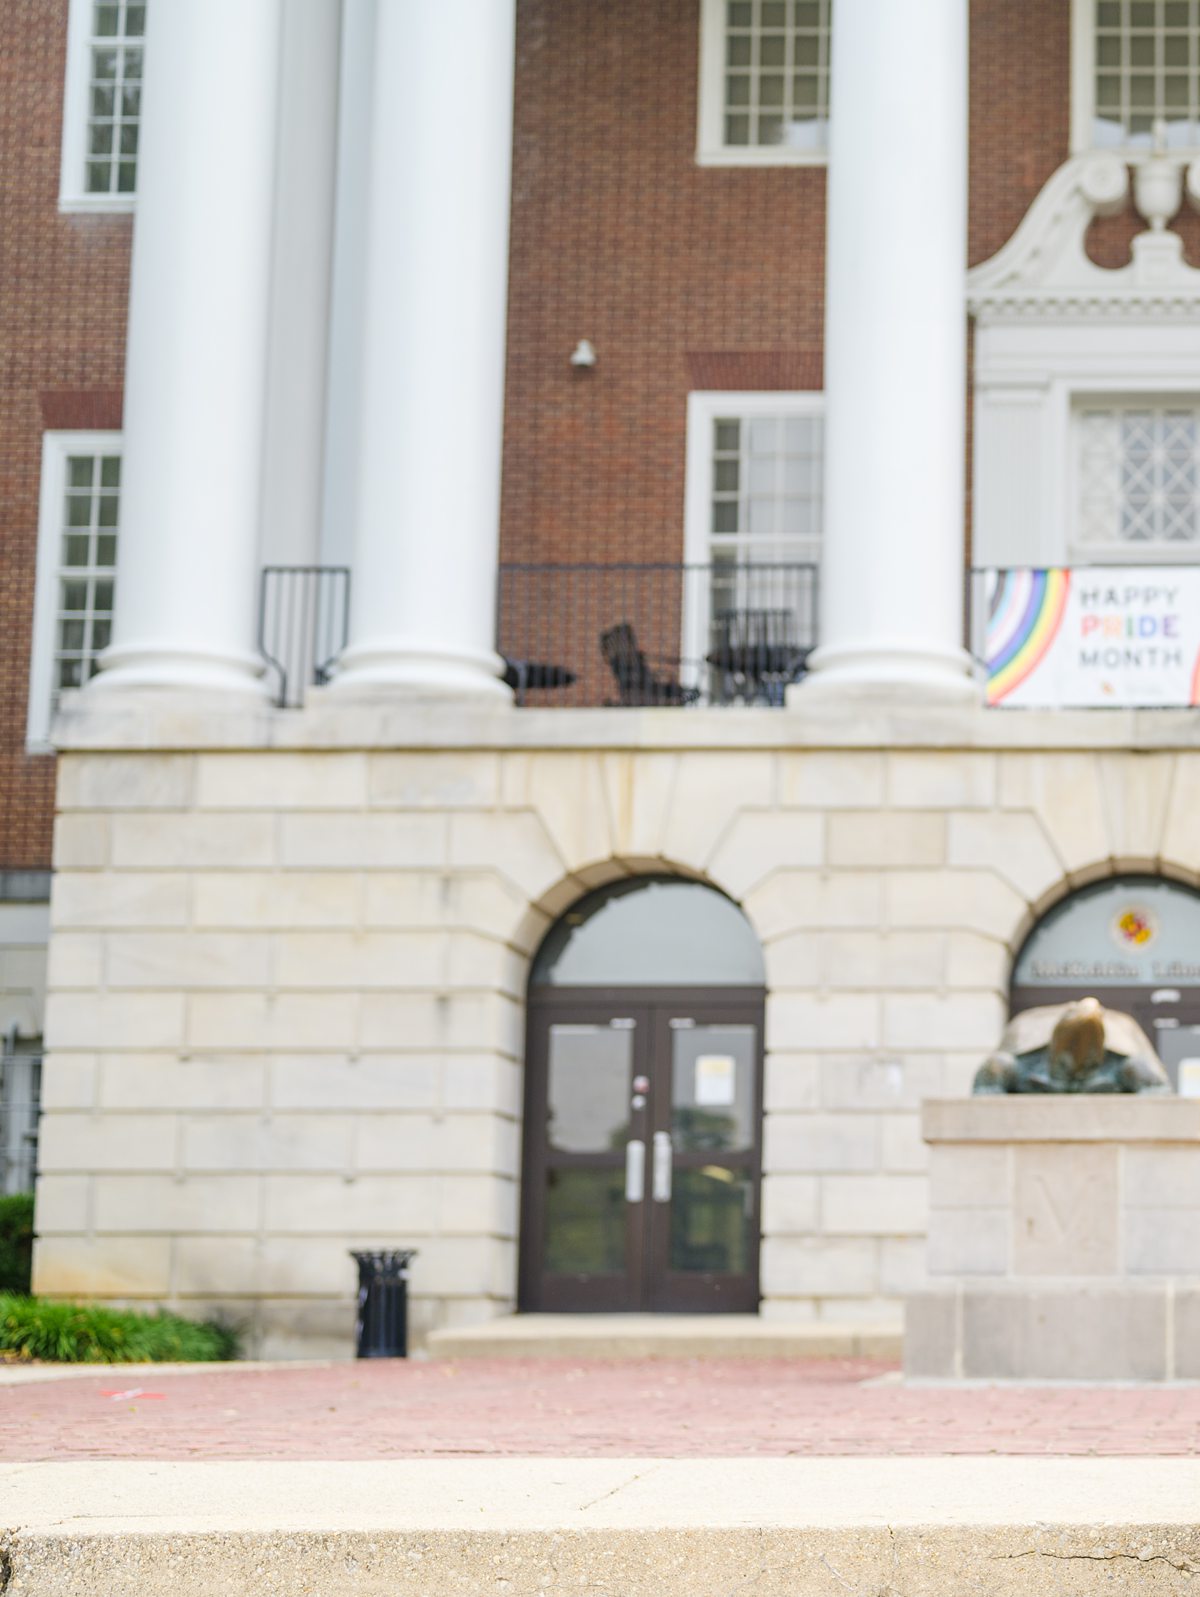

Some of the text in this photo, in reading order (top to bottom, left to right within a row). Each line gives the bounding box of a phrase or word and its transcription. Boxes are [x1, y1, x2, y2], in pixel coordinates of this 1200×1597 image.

[1080, 586, 1180, 607] HAPPY
[1081, 615, 1179, 638] PRIDE
[1079, 647, 1183, 669] MONTH
